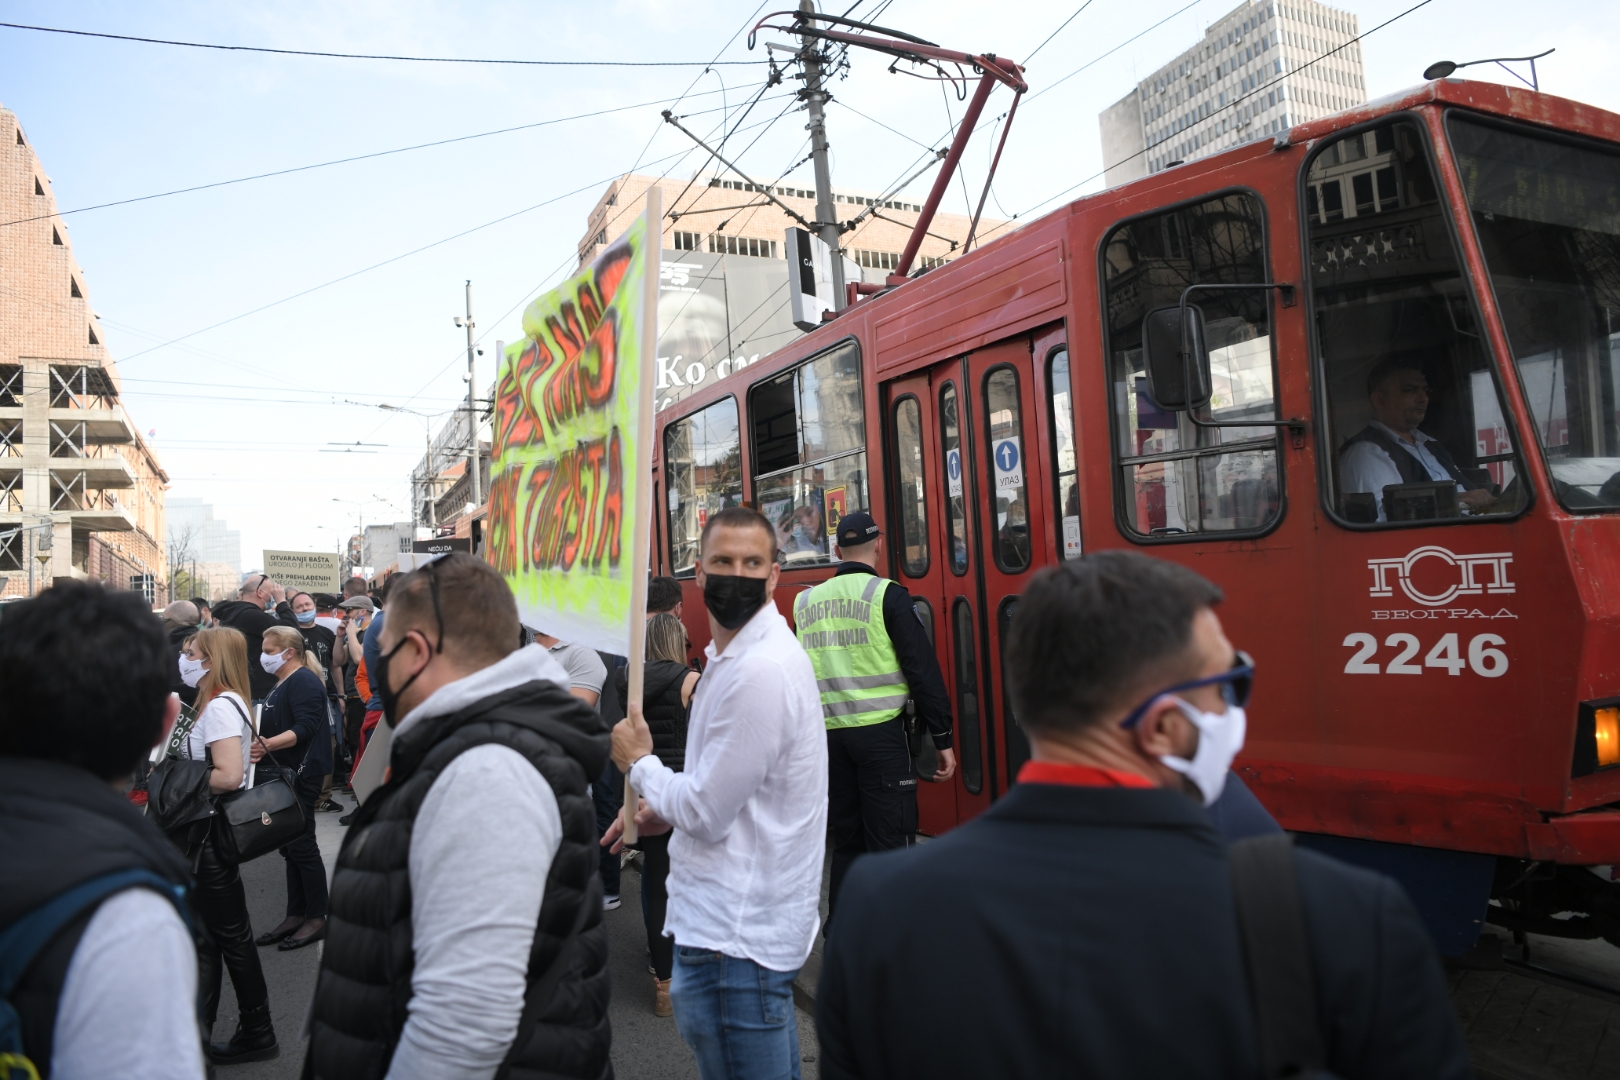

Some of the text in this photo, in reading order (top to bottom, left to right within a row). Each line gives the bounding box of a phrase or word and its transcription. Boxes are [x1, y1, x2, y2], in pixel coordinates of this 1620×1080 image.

[270, 555, 307, 563] OTVARANJE
[1368, 545, 1516, 606] ГСП
[797, 597, 871, 631] САОБРАЋАЈНА
[1371, 608, 1518, 620] БЕОГРАД
[802, 627, 869, 650] ПОЛИЦИЈА
[1342, 632, 1509, 678] 2246
